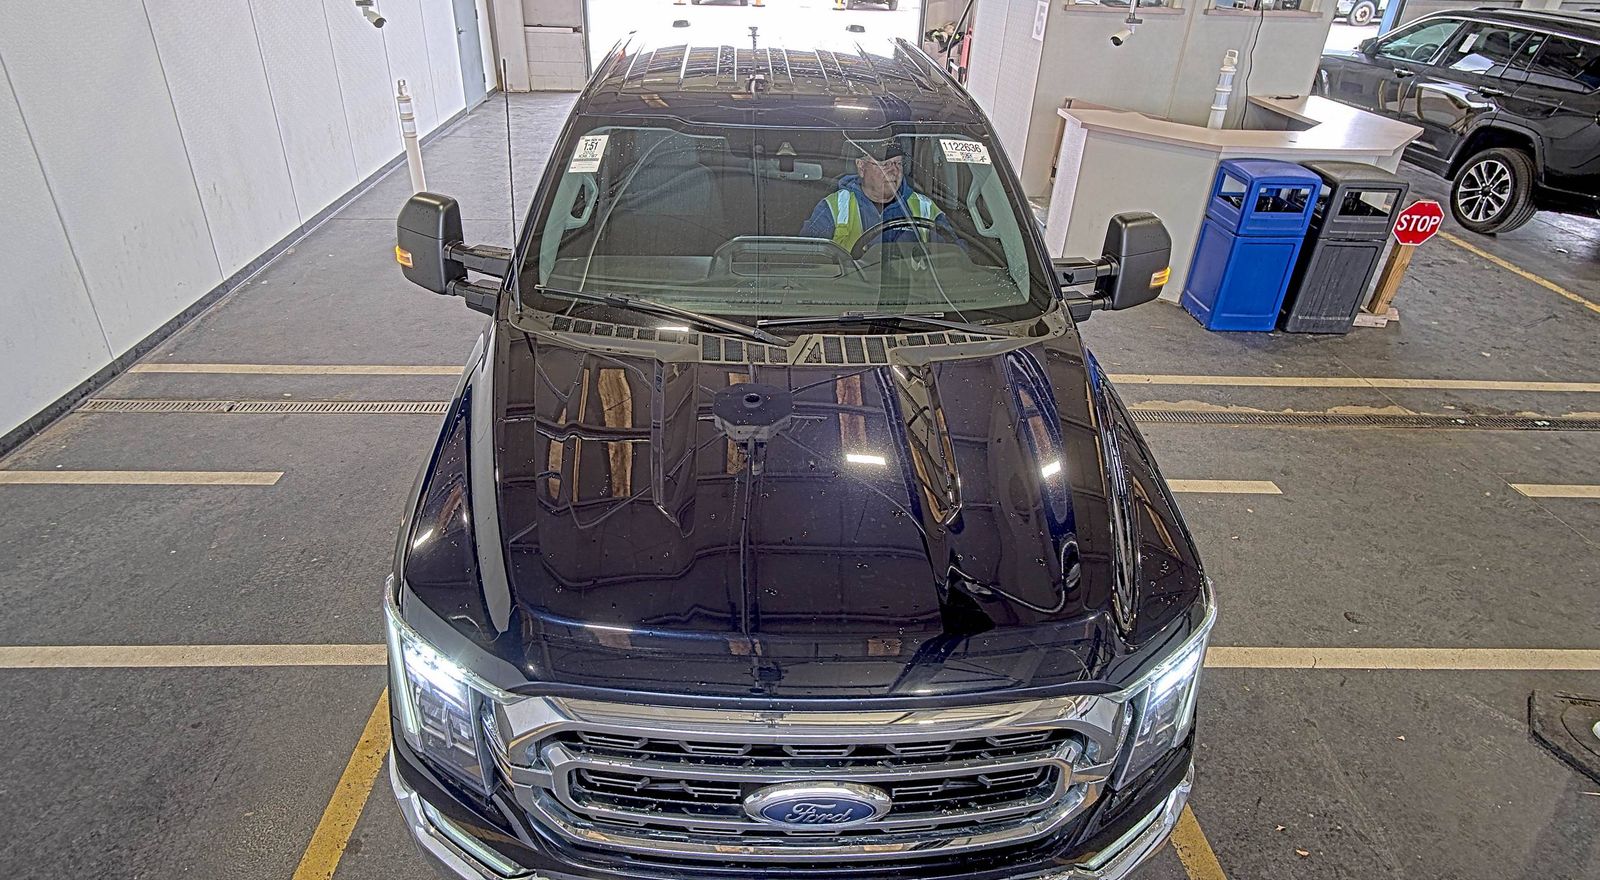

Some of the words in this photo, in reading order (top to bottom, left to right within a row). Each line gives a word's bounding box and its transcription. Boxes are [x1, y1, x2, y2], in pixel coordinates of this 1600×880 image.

[1035, 5, 1046, 36] 5
[1397, 214, 1440, 233] STOP
[784, 802, 853, 824] Ford
